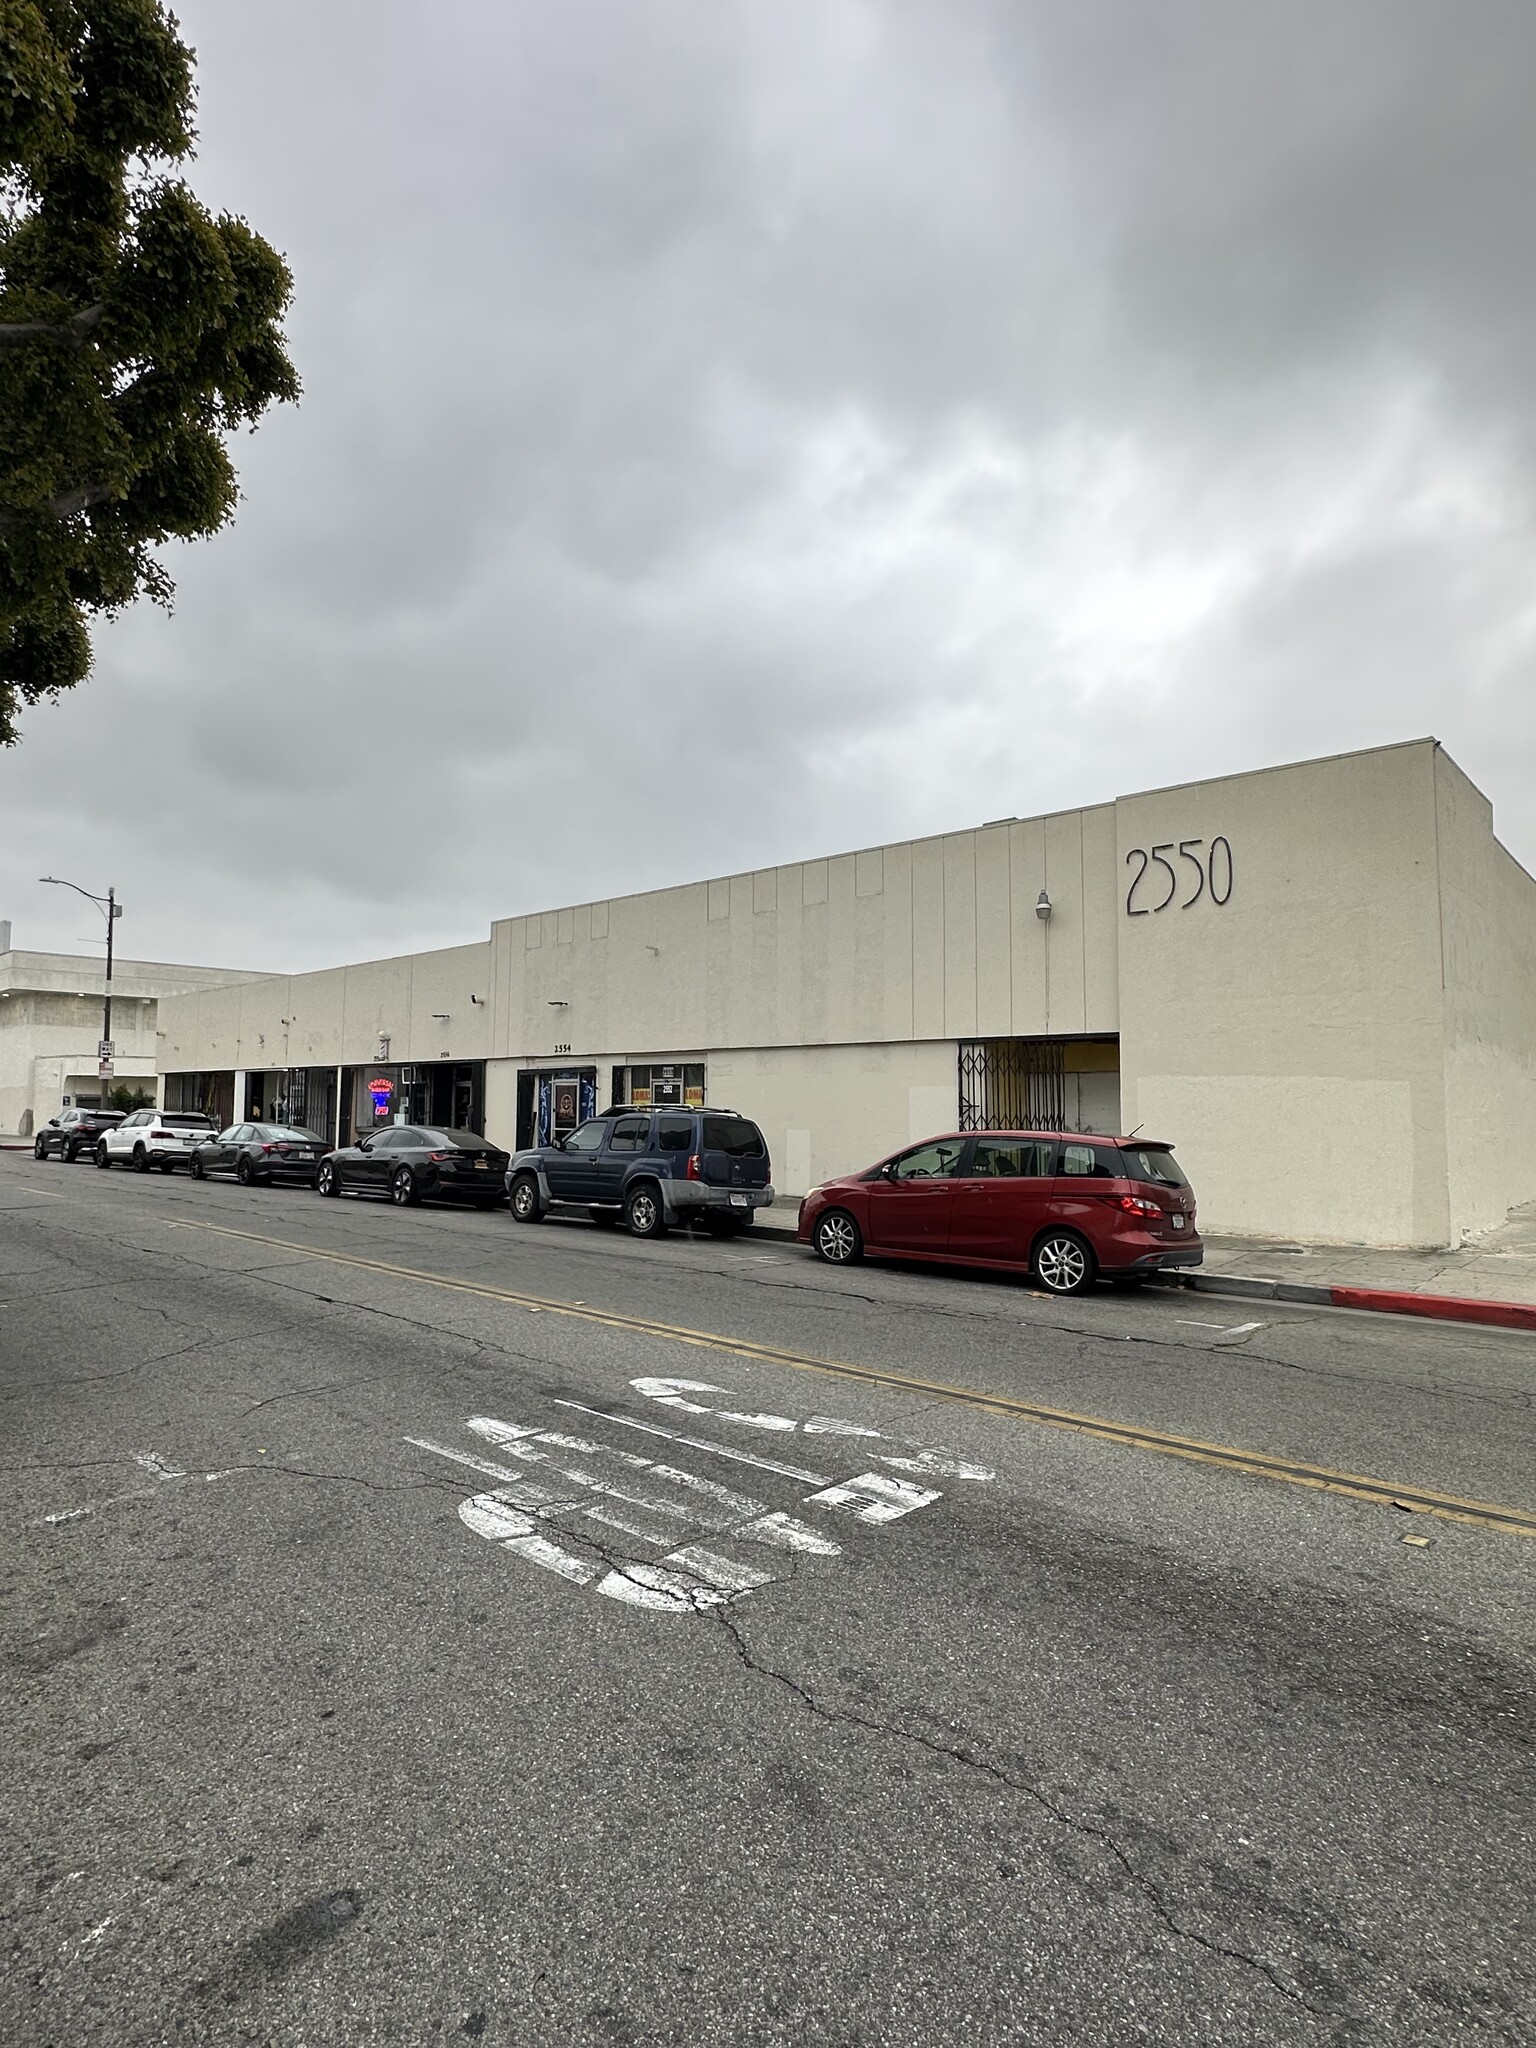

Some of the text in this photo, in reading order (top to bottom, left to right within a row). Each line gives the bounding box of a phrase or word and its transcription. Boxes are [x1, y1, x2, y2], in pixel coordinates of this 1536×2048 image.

[1126, 836, 1233, 916] 2550
[554, 1044, 572, 1053] 2554
[403, 1376, 998, 1613] STOP
